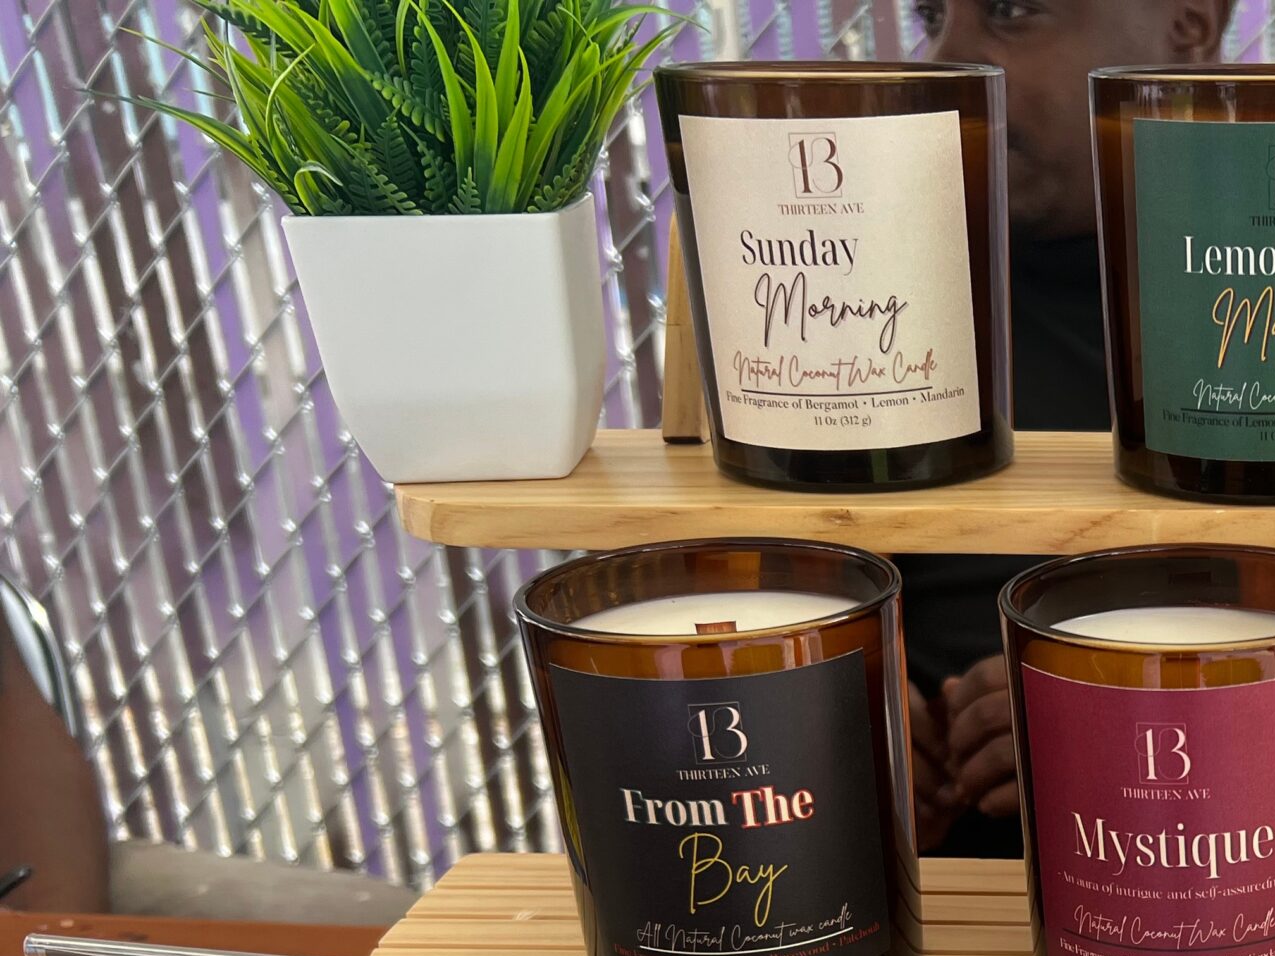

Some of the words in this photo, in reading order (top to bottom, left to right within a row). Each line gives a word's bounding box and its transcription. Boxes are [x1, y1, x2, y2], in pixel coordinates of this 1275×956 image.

[778, 204, 838, 215] THIRTEEN
[841, 203, 864, 214] AVE
[740, 229, 858, 276] Sunday
[754, 272, 907, 353] Morning
[733, 351, 784, 387] Natural
[789, 355, 852, 390] Coconut
[848, 356, 886, 386] Wax
[893, 349, 937, 383] Candle
[726, 391, 741, 404] Fine
[743, 395, 789, 409] Fragrance
[792, 399, 802, 409] of
[805, 399, 859, 412] Bergamot
[872, 397, 909, 408] Lemon
[921, 387, 964, 403] Mandarin
[1193, 379, 1247, 411] Natural
[823, 417, 837, 425] Oz
[841, 416, 859, 426] (312
[1182, 411, 1228, 427] Fragrance
[698, 706, 748, 760] 13
[1145, 727, 1191, 780] 13
[676, 768, 741, 781] THIRTEEN
[744, 764, 770, 777] AVE
[620, 787, 730, 826] From
[731, 786, 814, 828] The
[1121, 787, 1182, 800] THIRTEEN
[1185, 788, 1210, 799] AVE
[1071, 811, 1274, 879] Mystique
[679, 832, 788, 927] Bay
[1077, 877, 1099, 892] aura
[1102, 882, 1114, 896] of
[1115, 886, 1163, 899] intrigue
[1167, 886, 1191, 900] and
[636, 921, 661, 948] All
[666, 924, 725, 950] Natural
[731, 922, 796, 950] Coconut
[789, 925, 813, 937] wax
[818, 902, 852, 931] candle
[1074, 905, 1127, 942] Natural
[1130, 916, 1192, 949] Coconut
[1188, 919, 1226, 946] Wax
